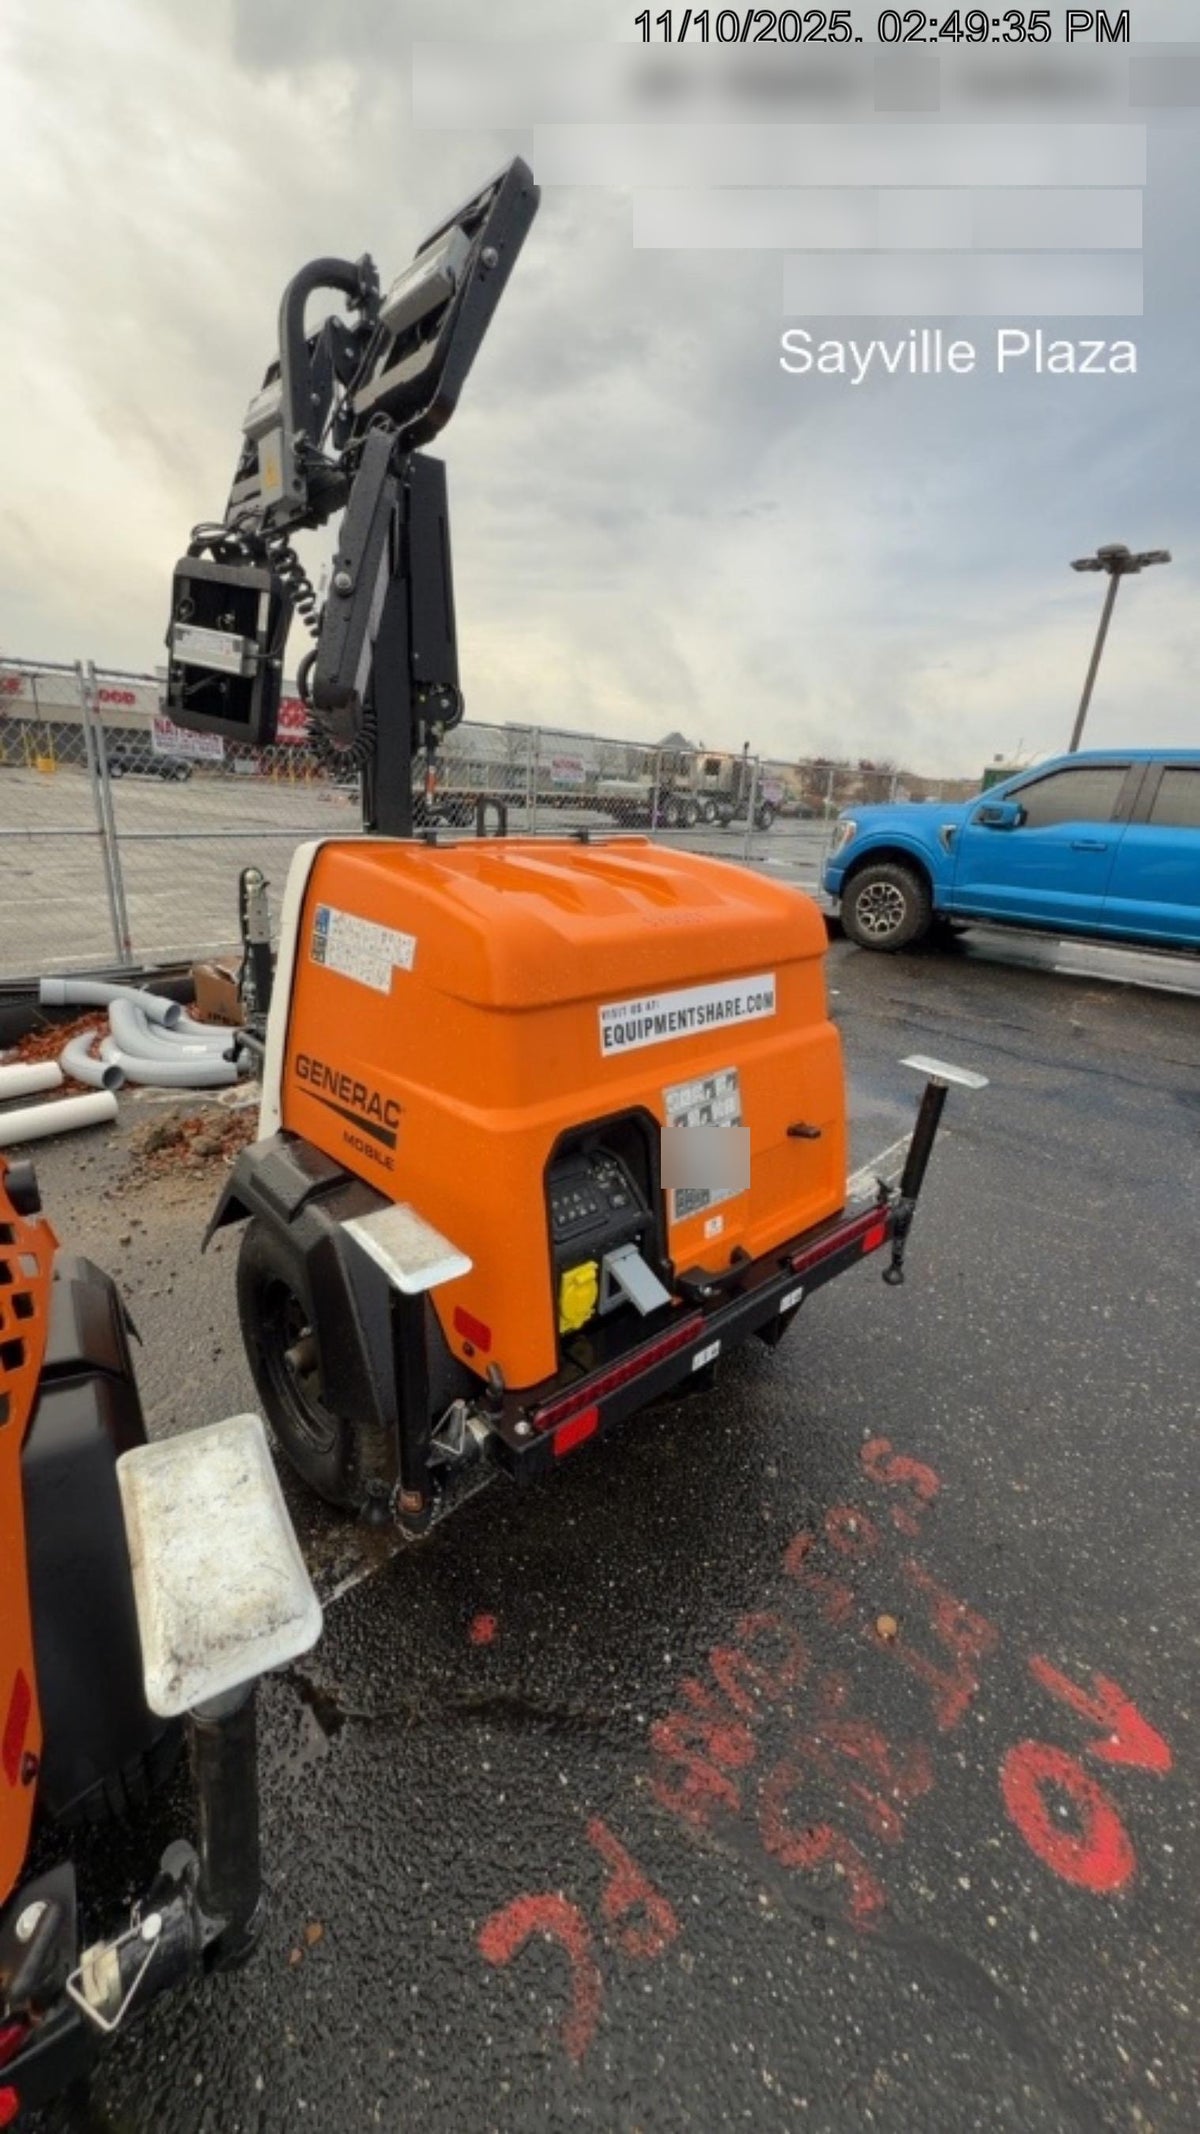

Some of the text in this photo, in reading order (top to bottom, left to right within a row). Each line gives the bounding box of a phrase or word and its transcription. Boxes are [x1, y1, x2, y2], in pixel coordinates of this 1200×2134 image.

[603, 990, 774, 1047] EQUIPMENTSHARE.COM
[295, 1053, 401, 1129] GENERAC
[343, 1130, 395, 1172] MOBILE
